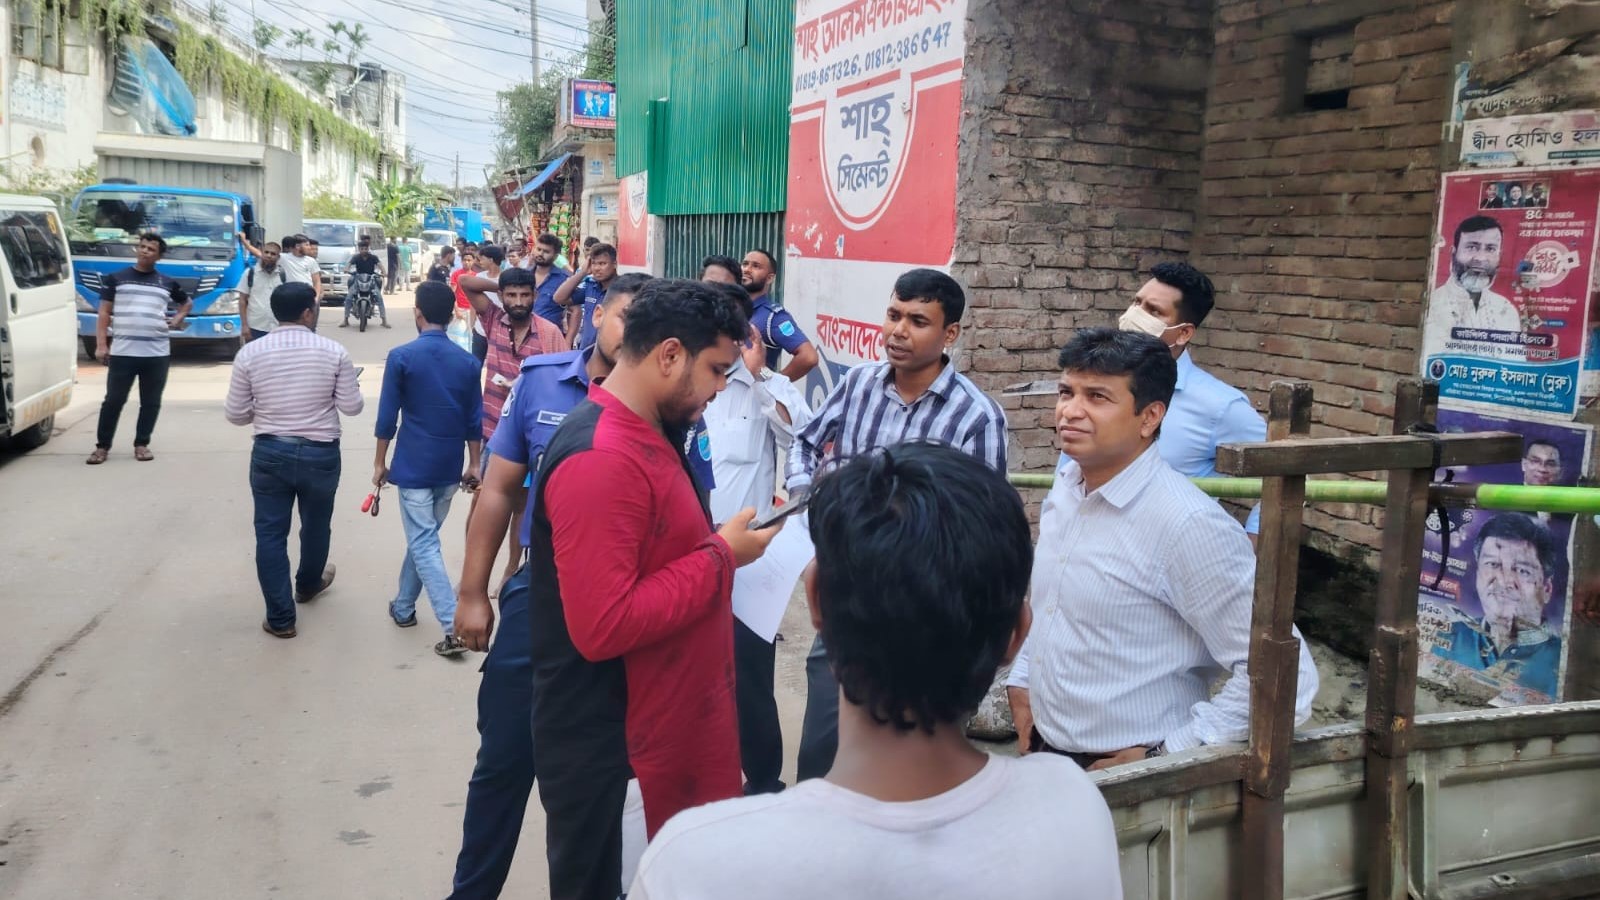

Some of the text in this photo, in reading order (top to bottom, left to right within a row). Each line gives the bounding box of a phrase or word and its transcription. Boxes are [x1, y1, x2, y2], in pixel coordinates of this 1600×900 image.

[840, 92, 895, 147] শাহ্
[1505, 127, 1563, 149] হোমিও
[837, 149, 891, 192] সিমেন্ট
[1448, 364, 1468, 379] মোঃ
[1470, 366, 1498, 383] নুরুল
[1500, 365, 1538, 388] ইসলাম
[1541, 372, 1573, 396] (নুরু)
